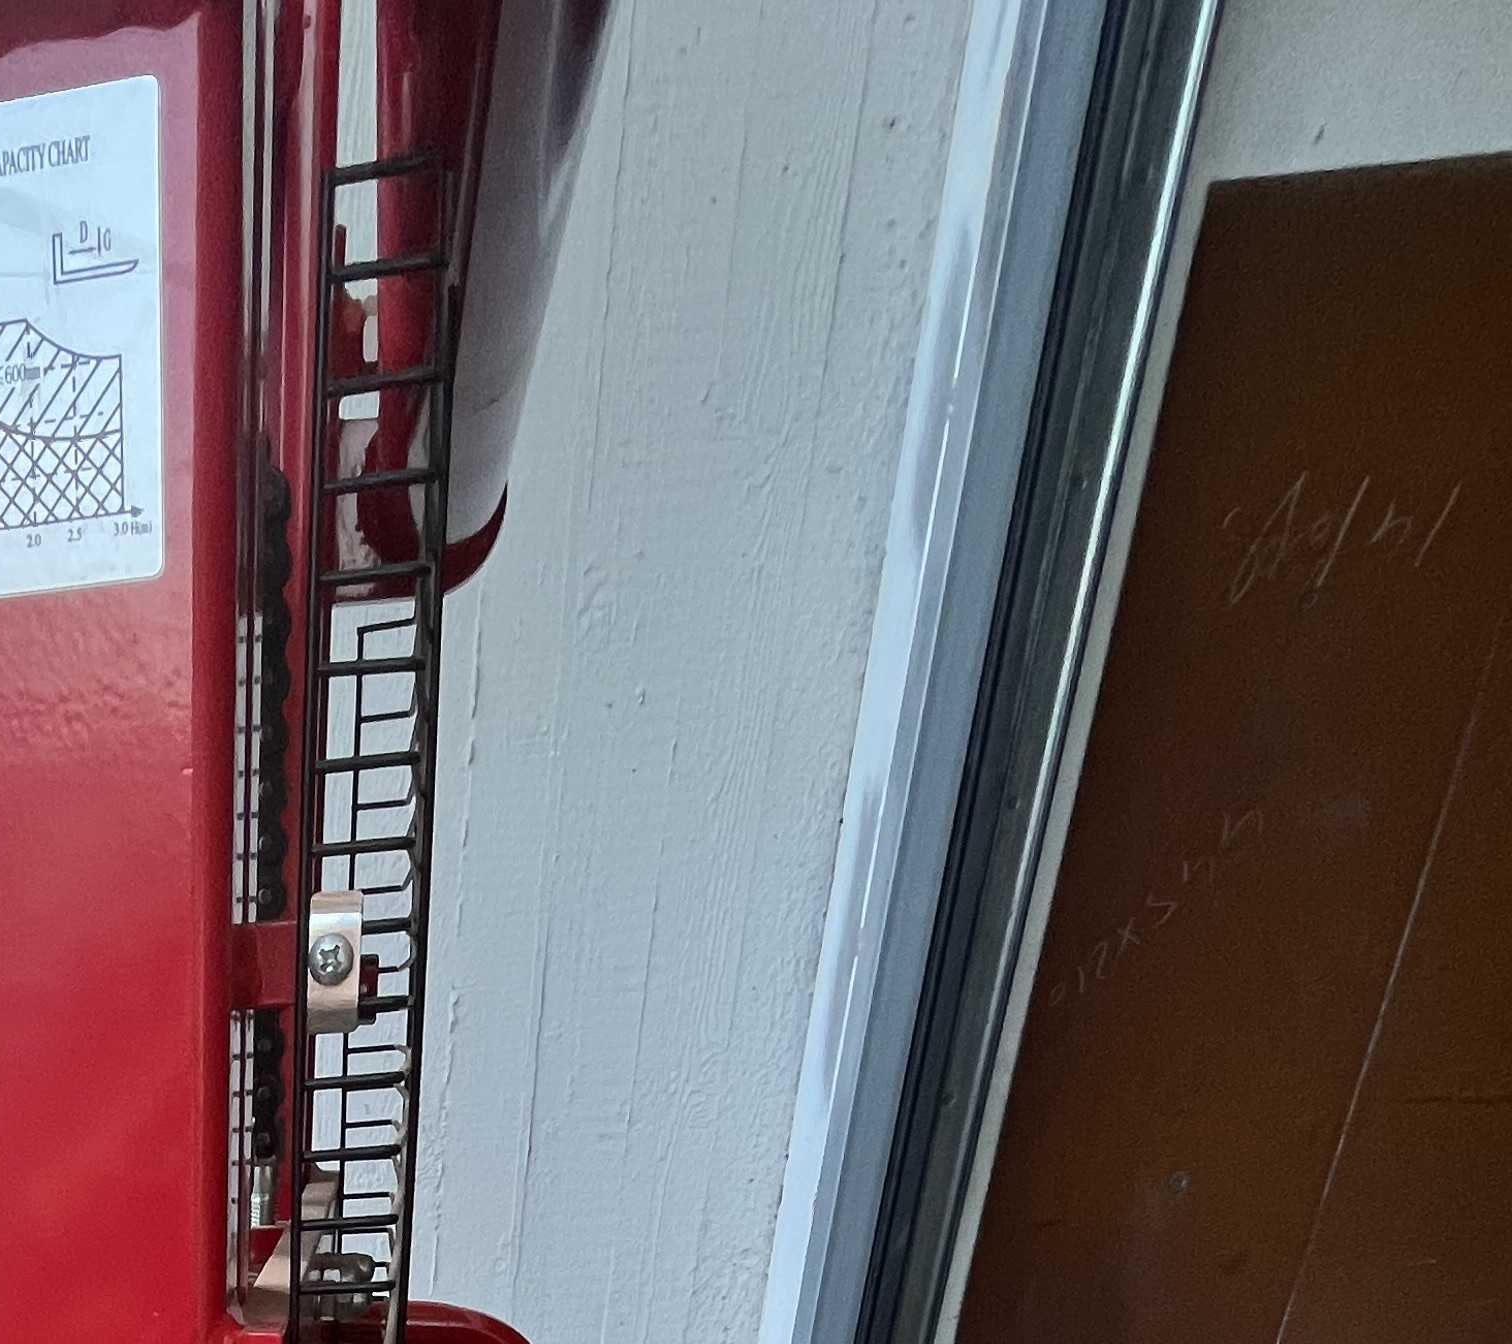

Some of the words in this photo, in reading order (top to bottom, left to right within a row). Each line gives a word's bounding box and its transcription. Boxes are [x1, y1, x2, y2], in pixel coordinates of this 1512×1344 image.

[47, 135, 91, 168] CHART
[79, 220, 88, 244] D
[26, 533, 42, 548] 2.0
[67, 528, 82, 542] 2.5
[113, 521, 129, 537] 3.0
